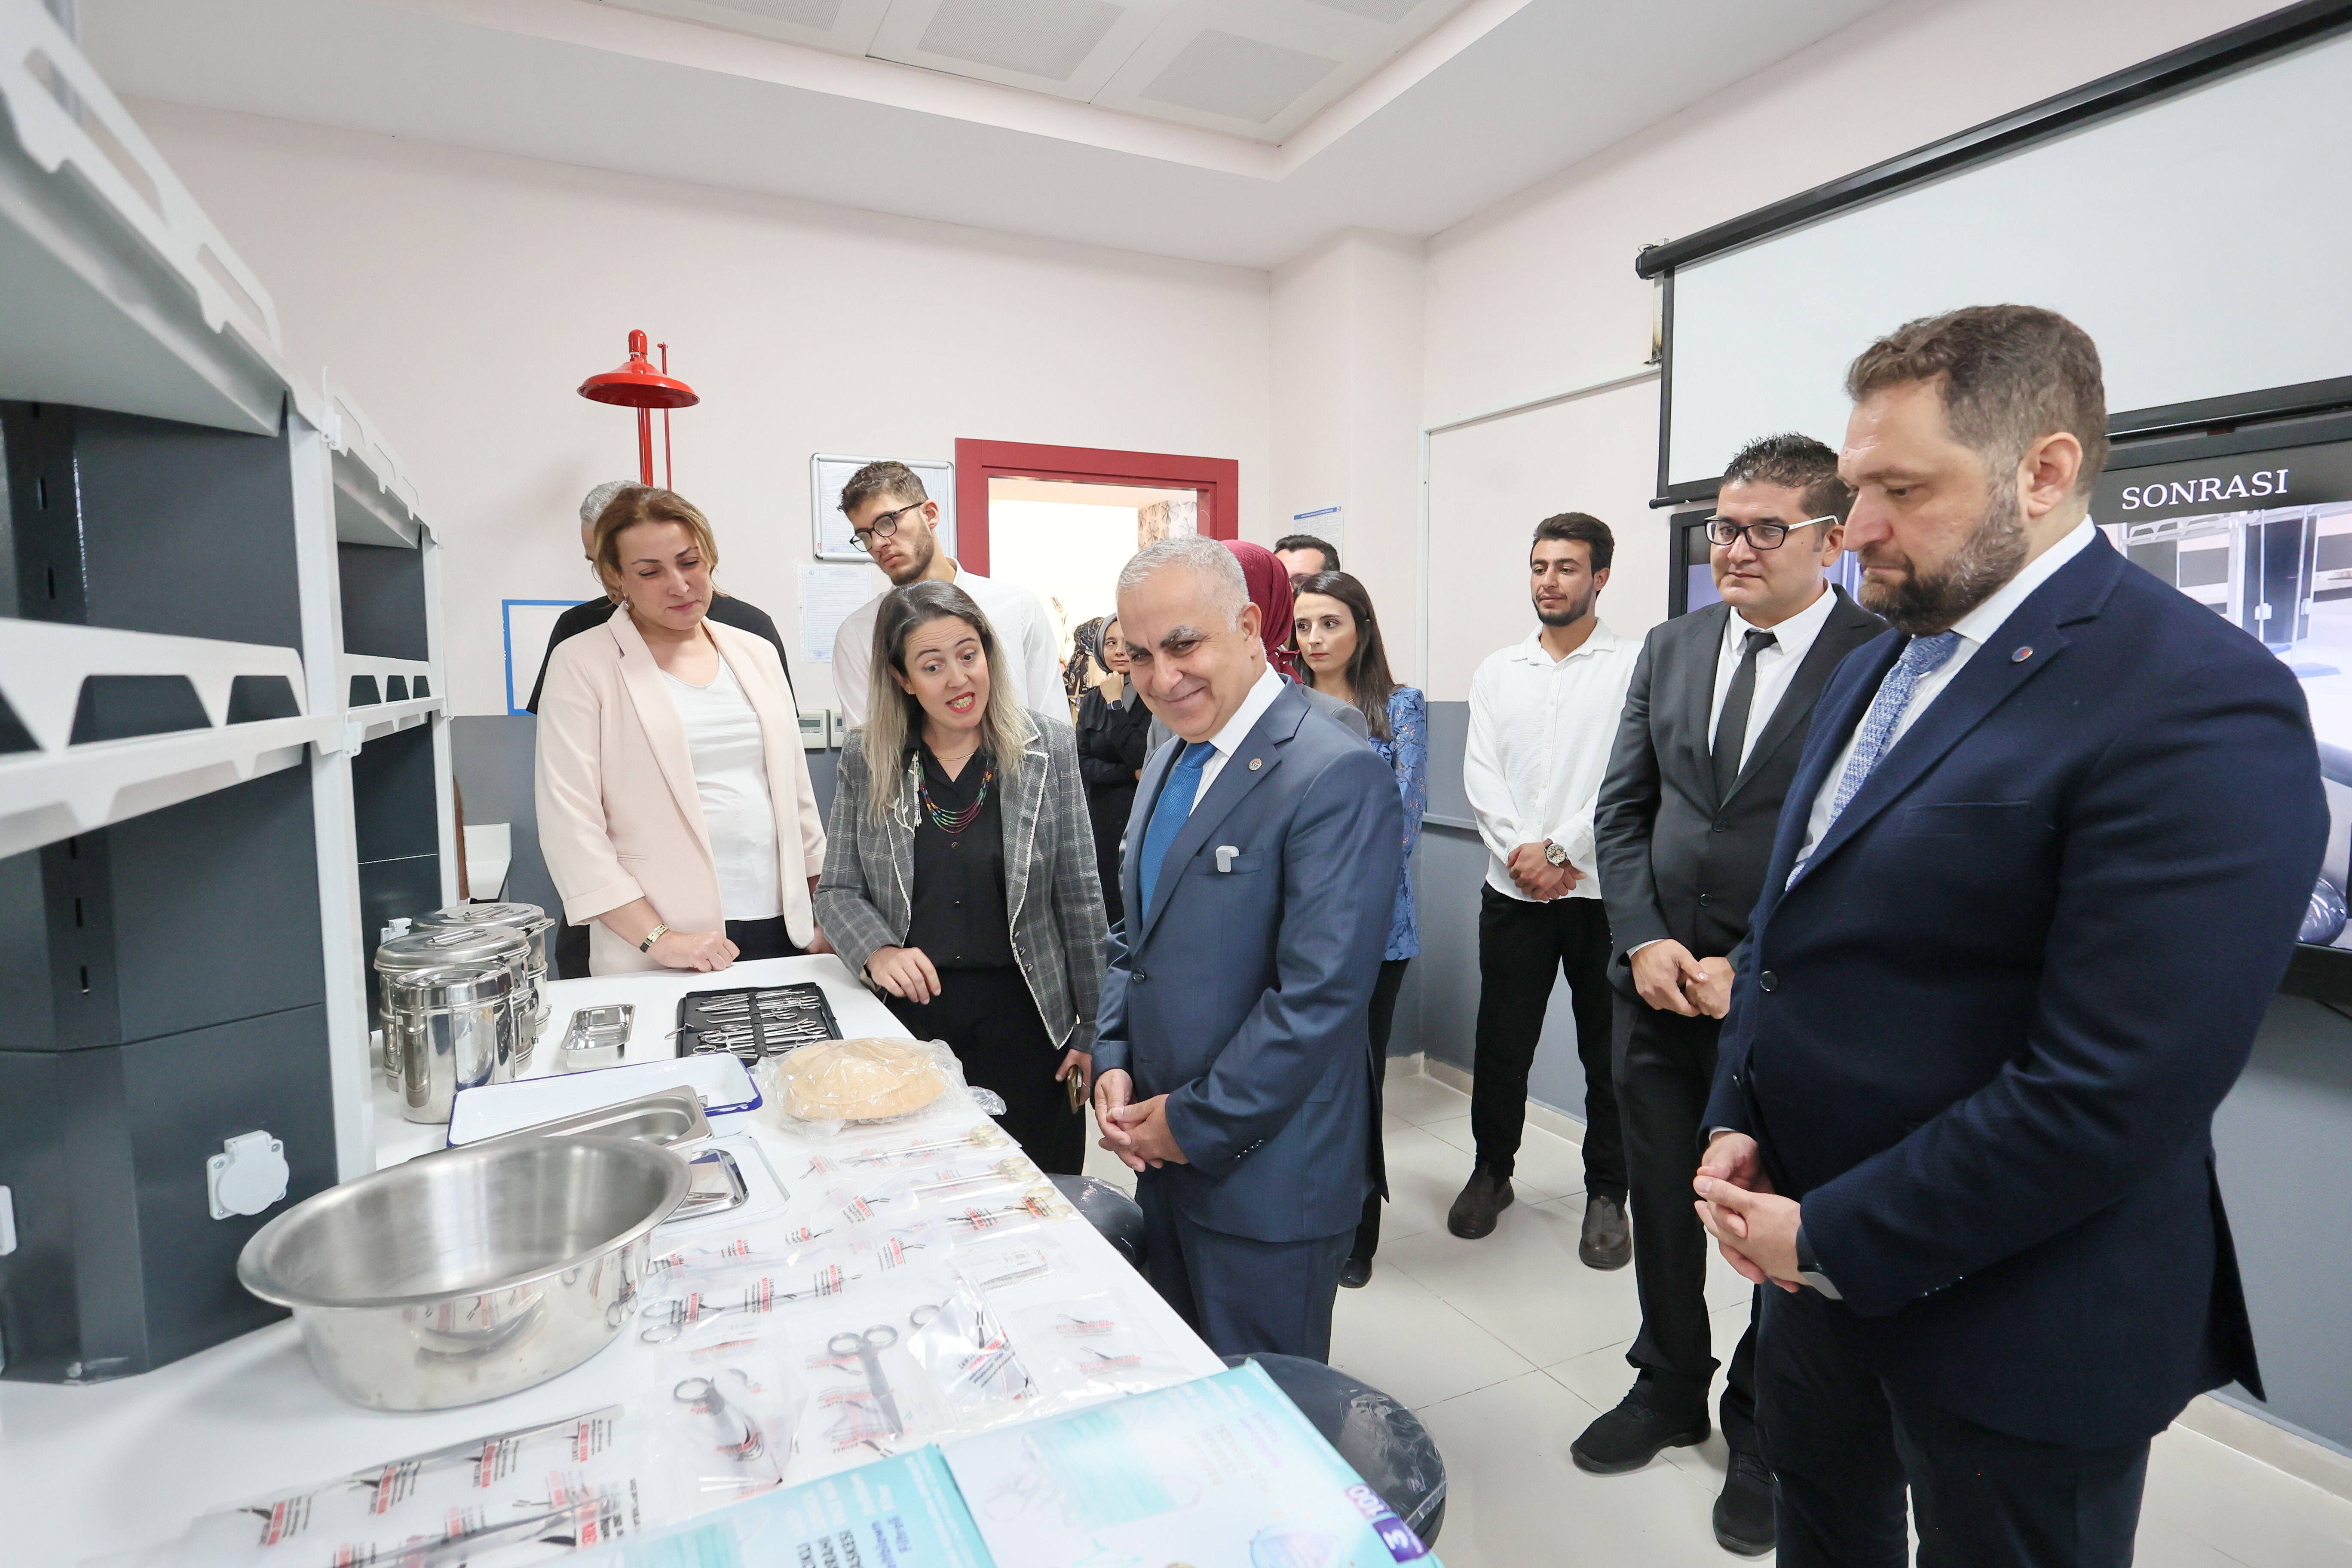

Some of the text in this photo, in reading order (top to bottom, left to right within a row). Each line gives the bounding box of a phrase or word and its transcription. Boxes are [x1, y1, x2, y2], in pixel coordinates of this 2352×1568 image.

[2122, 469, 2289, 510] SONRASI
[1350, 1485, 1385, 1516] 100
[1382, 1528, 1409, 1550] 3
